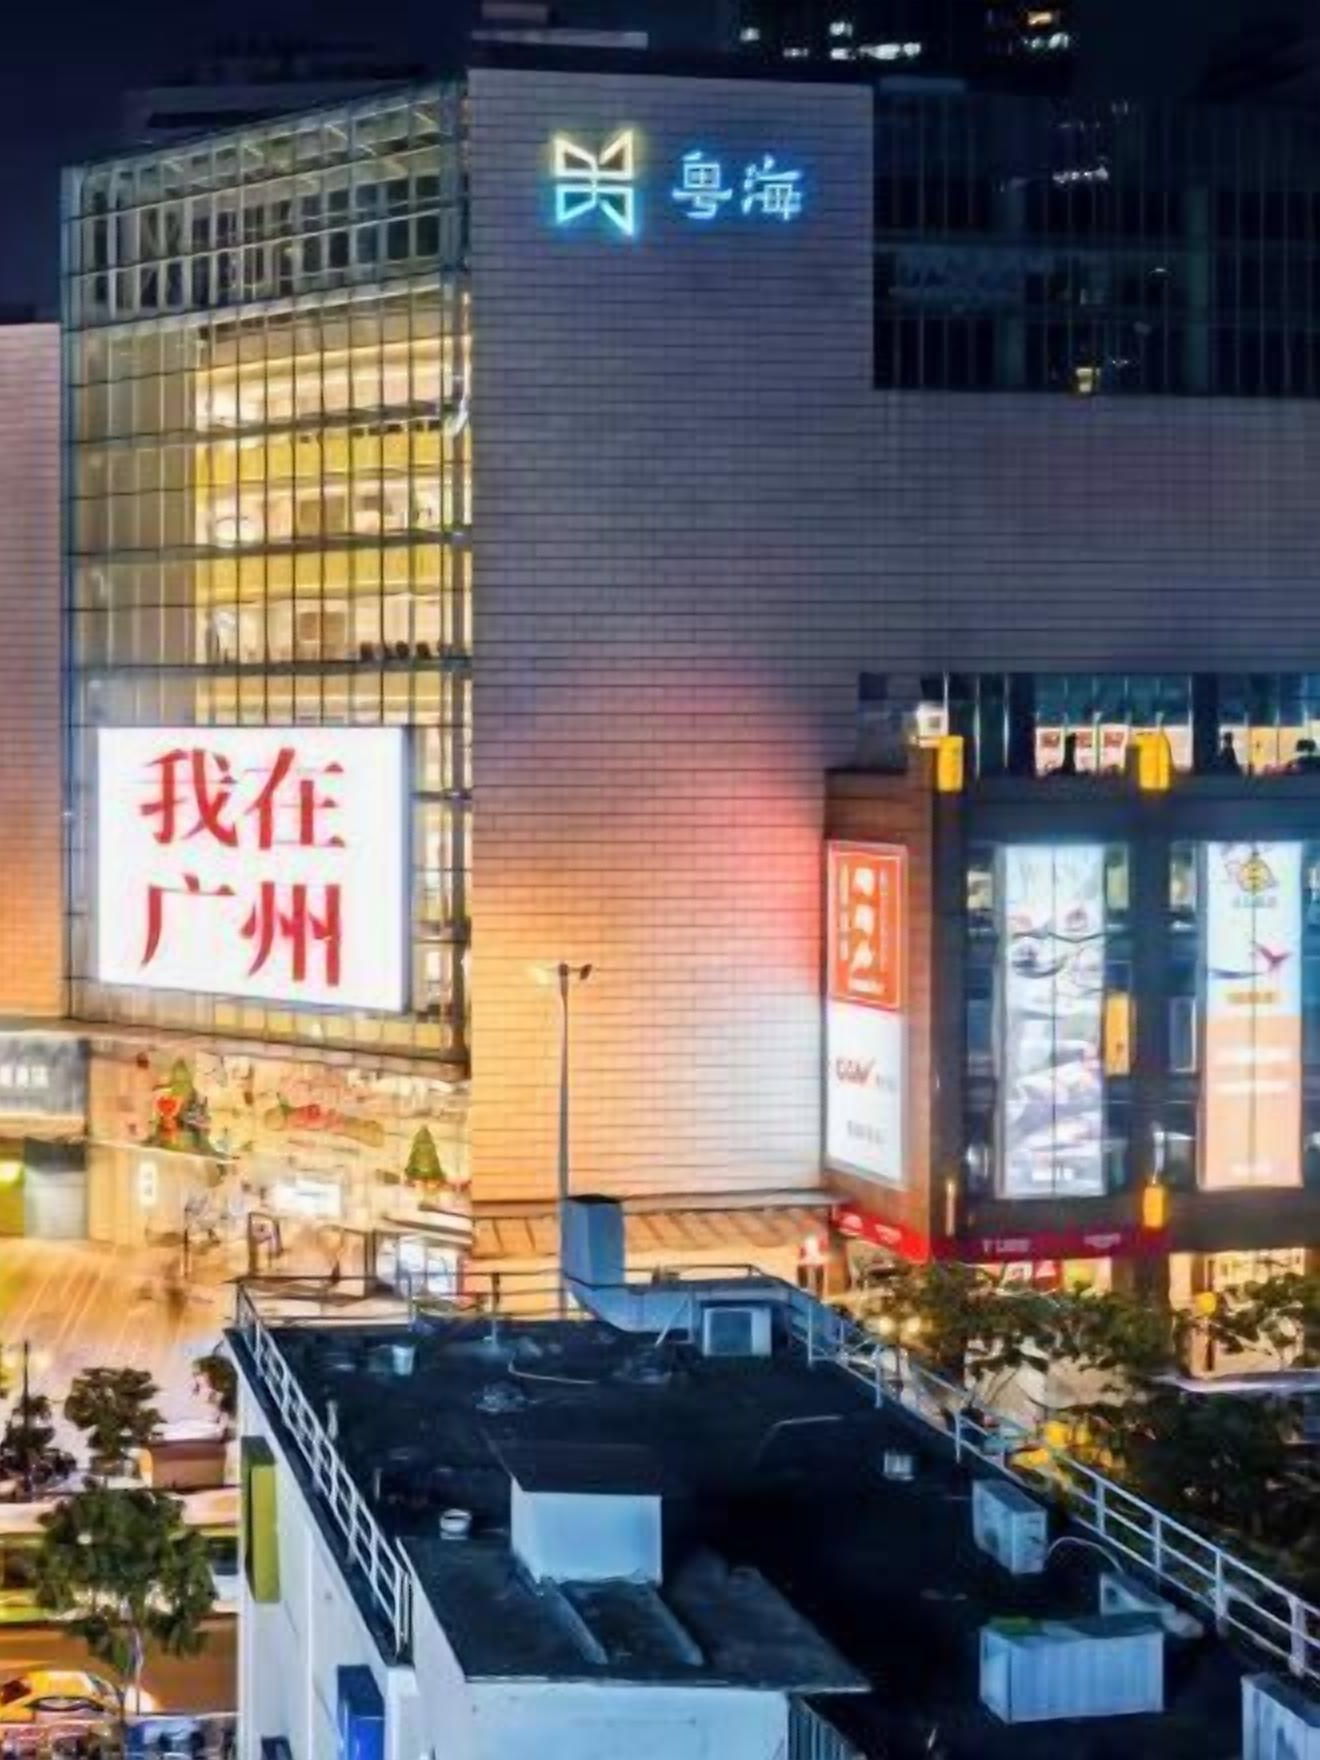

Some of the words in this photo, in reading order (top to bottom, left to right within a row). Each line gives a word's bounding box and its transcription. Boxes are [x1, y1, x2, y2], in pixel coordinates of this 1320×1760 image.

[671, 149, 803, 221] 粤海
[138, 746, 348, 852] 我在
[138, 872, 344, 988] 广州
